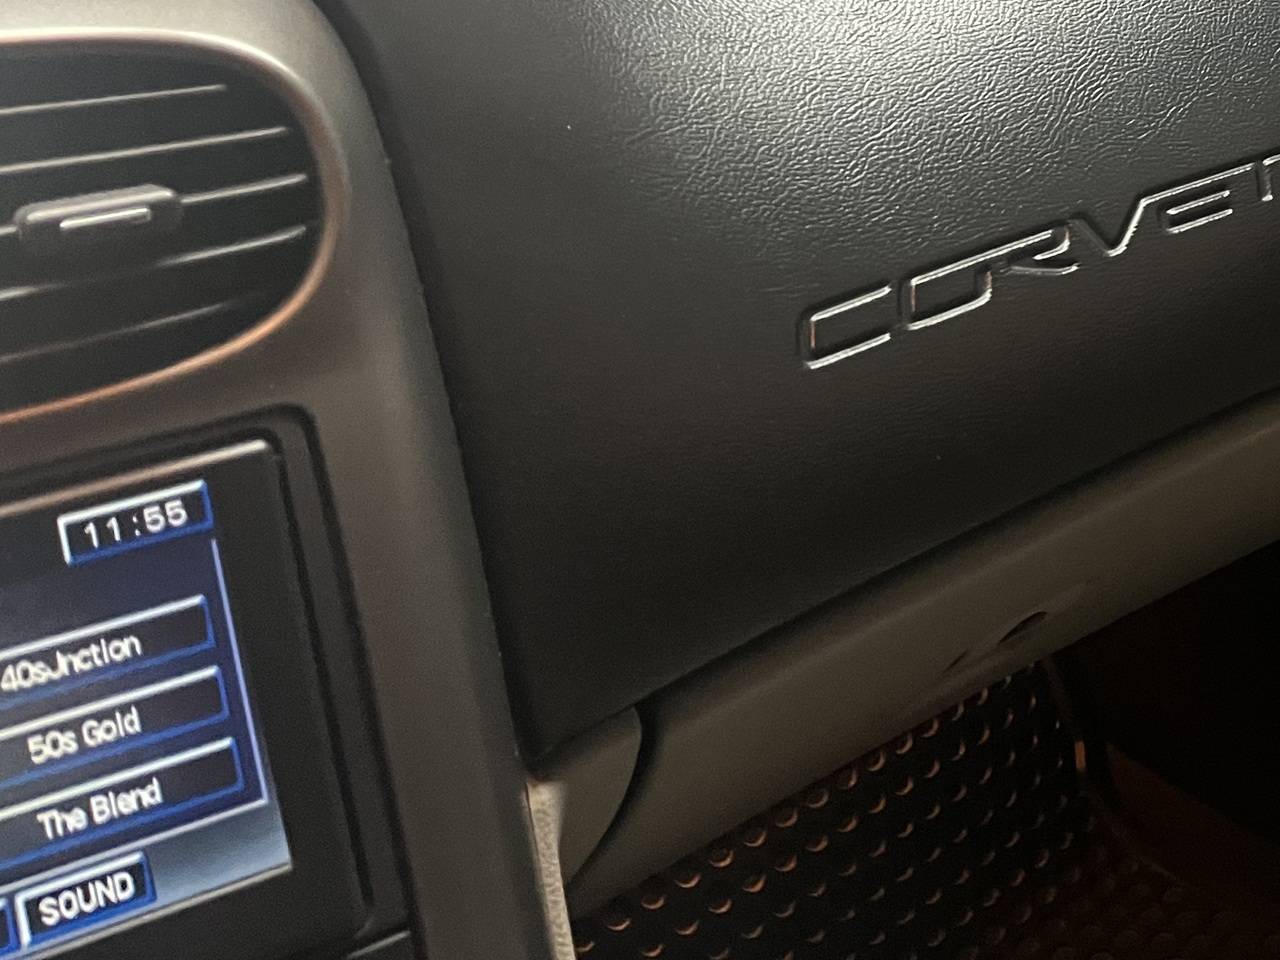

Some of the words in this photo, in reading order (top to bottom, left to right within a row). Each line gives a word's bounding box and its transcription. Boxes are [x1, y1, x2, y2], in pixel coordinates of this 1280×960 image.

[84, 499, 188, 549] 11:55
[26, 730, 79, 765] 50s
[81, 704, 142, 747] Gold
[36, 807, 88, 840] The
[89, 776, 164, 825] Blend
[38, 871, 135, 927] SOUND
